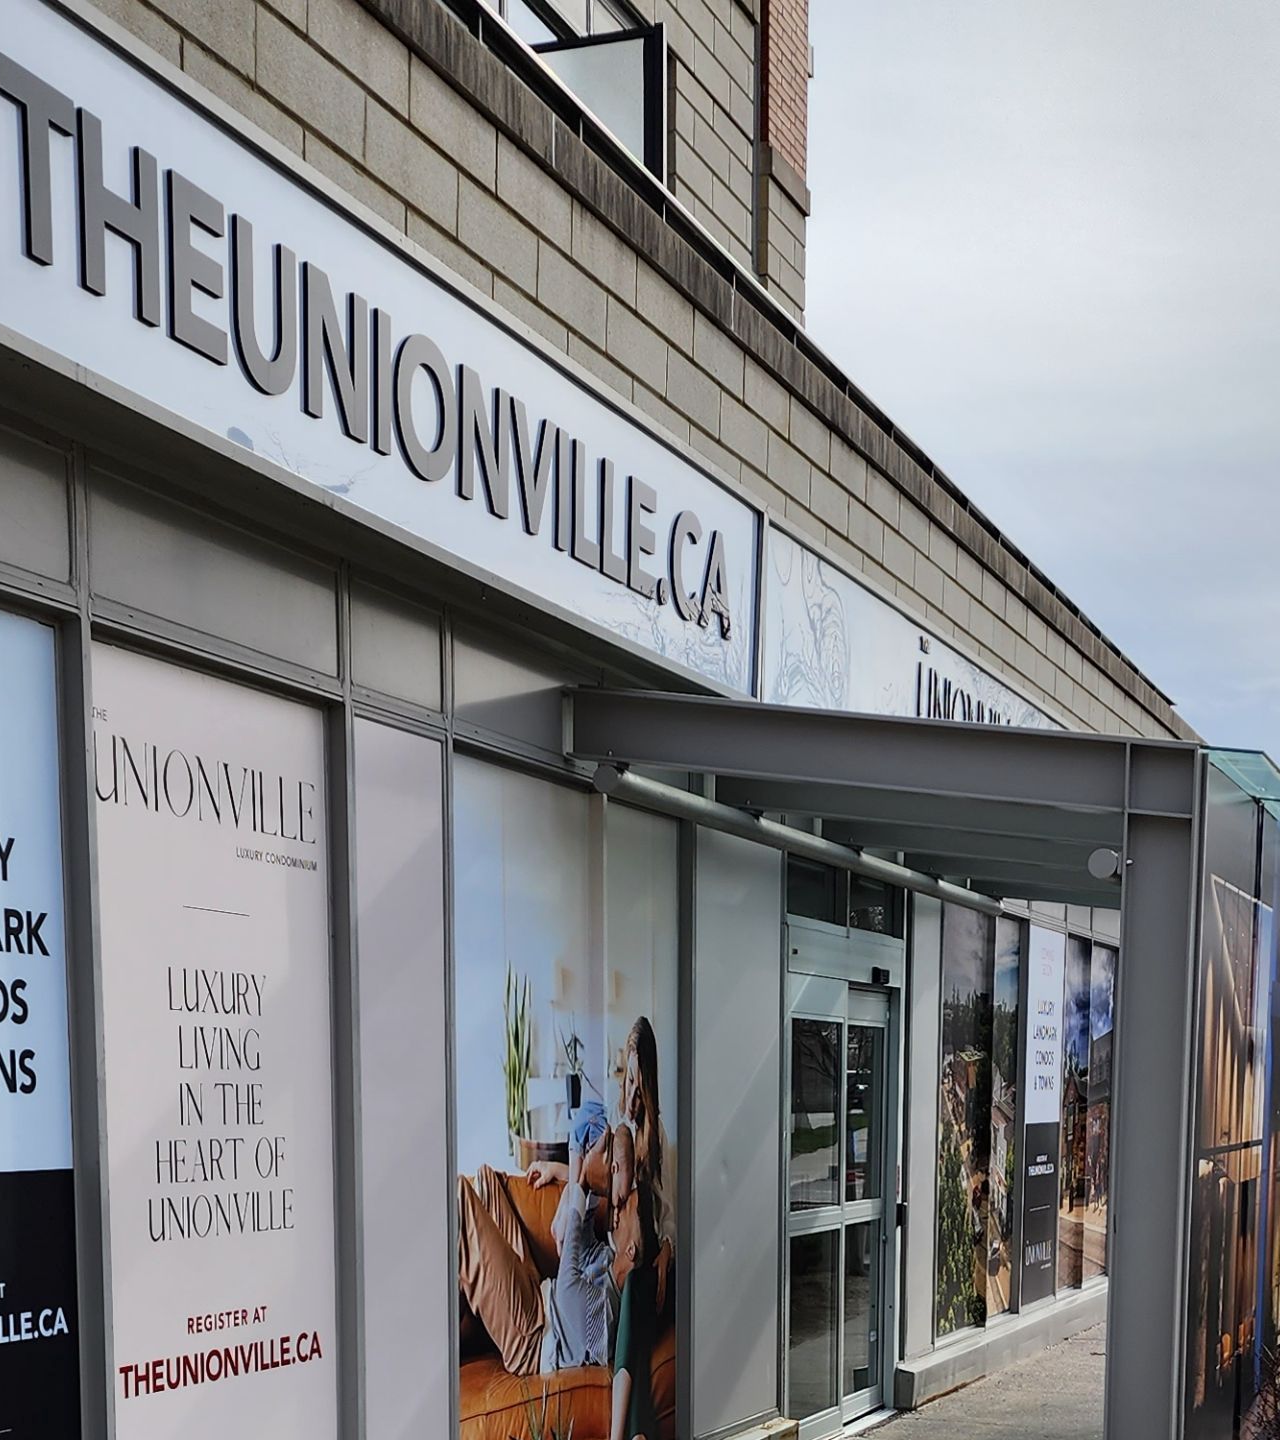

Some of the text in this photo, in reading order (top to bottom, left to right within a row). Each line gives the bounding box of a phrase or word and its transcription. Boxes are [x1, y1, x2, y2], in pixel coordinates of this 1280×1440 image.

[93, 730, 317, 844] UNIONVILLE
[236, 846, 318, 872] LUXURY CONDOMINIUM
[168, 966, 266, 1016] LUXURY
[178, 1025, 261, 1071] LIVING
[179, 1082, 264, 1126] IN THE
[156, 1136, 286, 1184] HEART OF
[148, 1188, 295, 1243] UNIONVILLE
[187, 1306, 268, 1334] REGISTER AT
[119, 1331, 322, 1399] THEUNIONVILLE.CA
